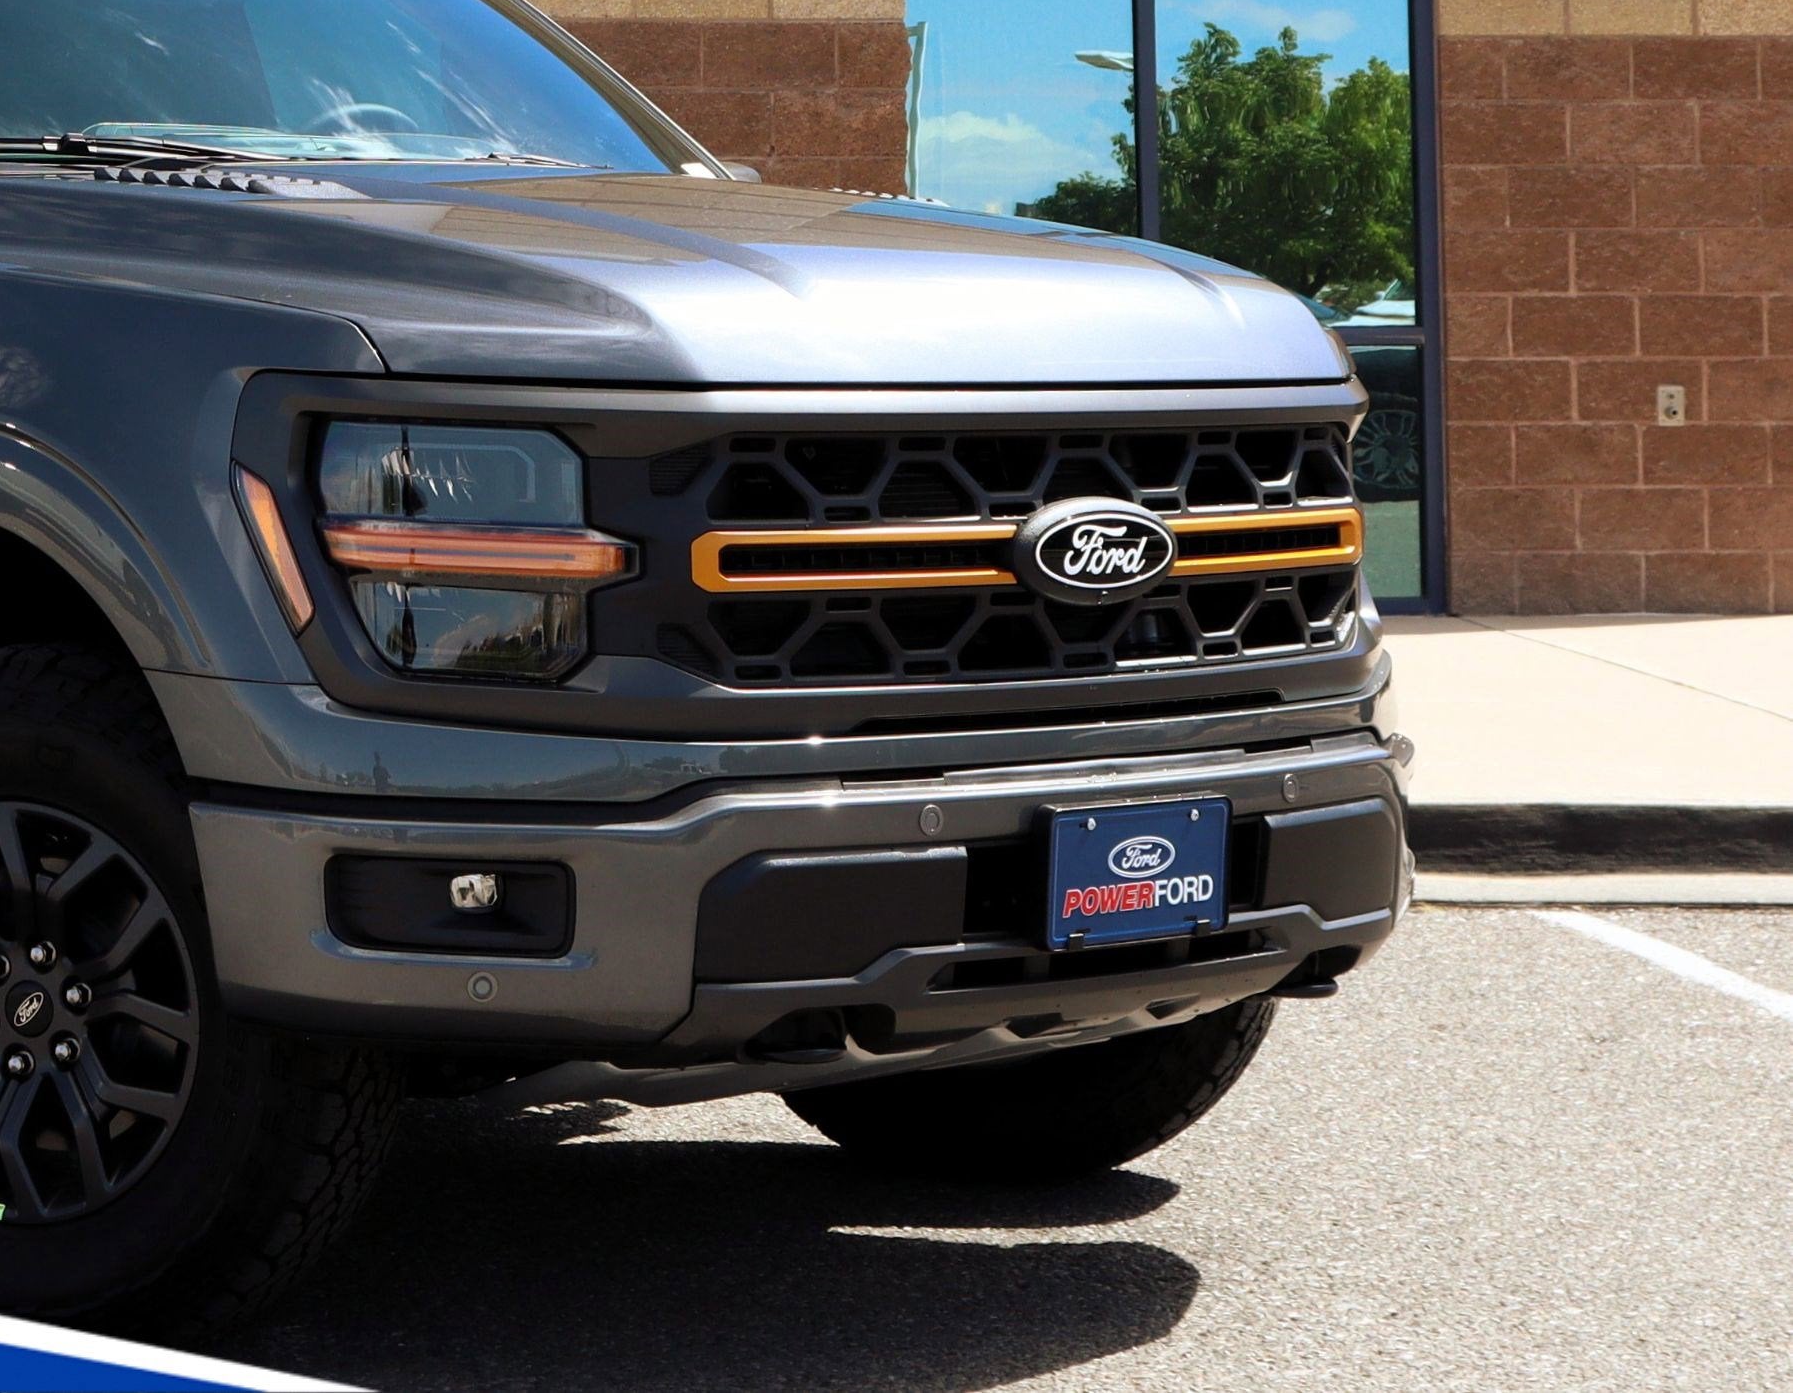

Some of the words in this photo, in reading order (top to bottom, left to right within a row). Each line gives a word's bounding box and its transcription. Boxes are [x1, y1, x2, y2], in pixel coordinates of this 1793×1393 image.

[1063, 524, 1149, 577] Ford
[1121, 842, 1163, 870] Ford
[1062, 873, 1214, 918] POWERFORD
[18, 996, 40, 1023] Ford
